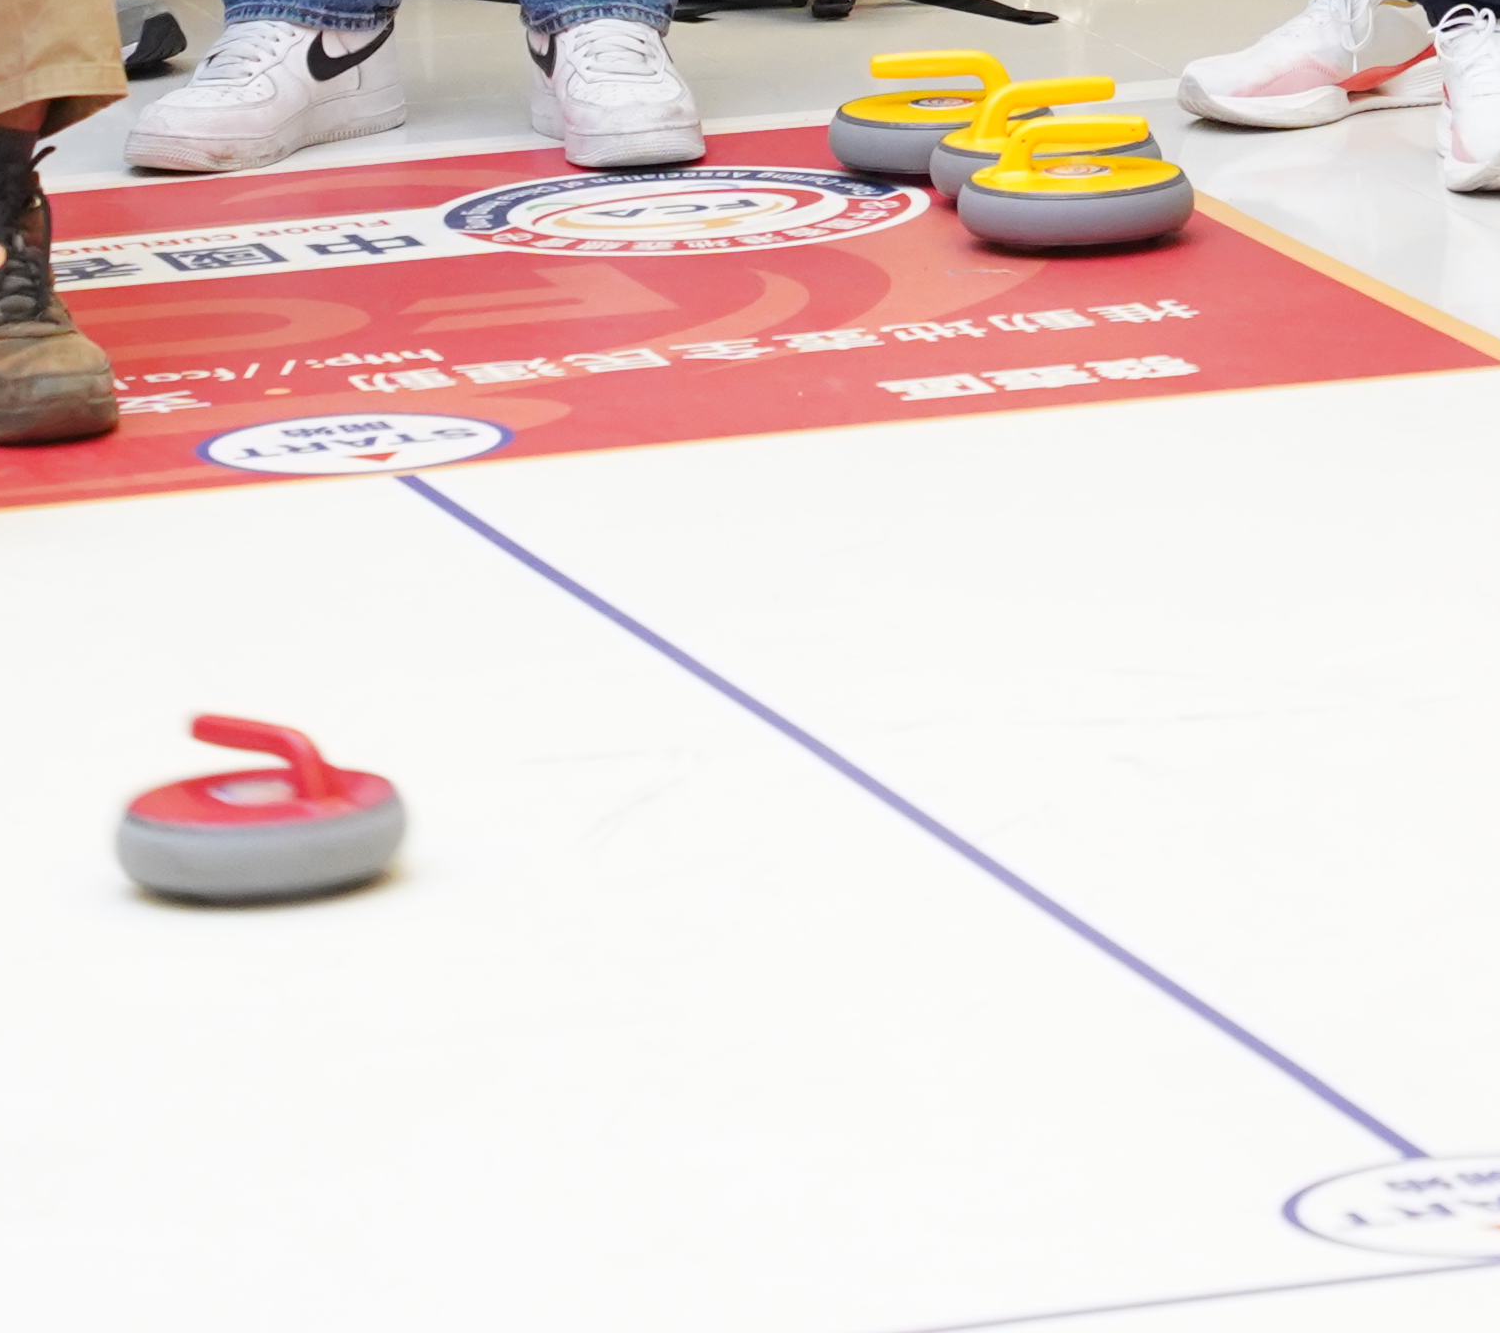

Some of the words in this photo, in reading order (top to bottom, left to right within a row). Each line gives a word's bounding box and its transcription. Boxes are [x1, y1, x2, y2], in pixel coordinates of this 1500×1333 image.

[586, 198, 762, 220] FCA
[308, 214, 392, 240] FLOOR
[235, 428, 478, 460] START
